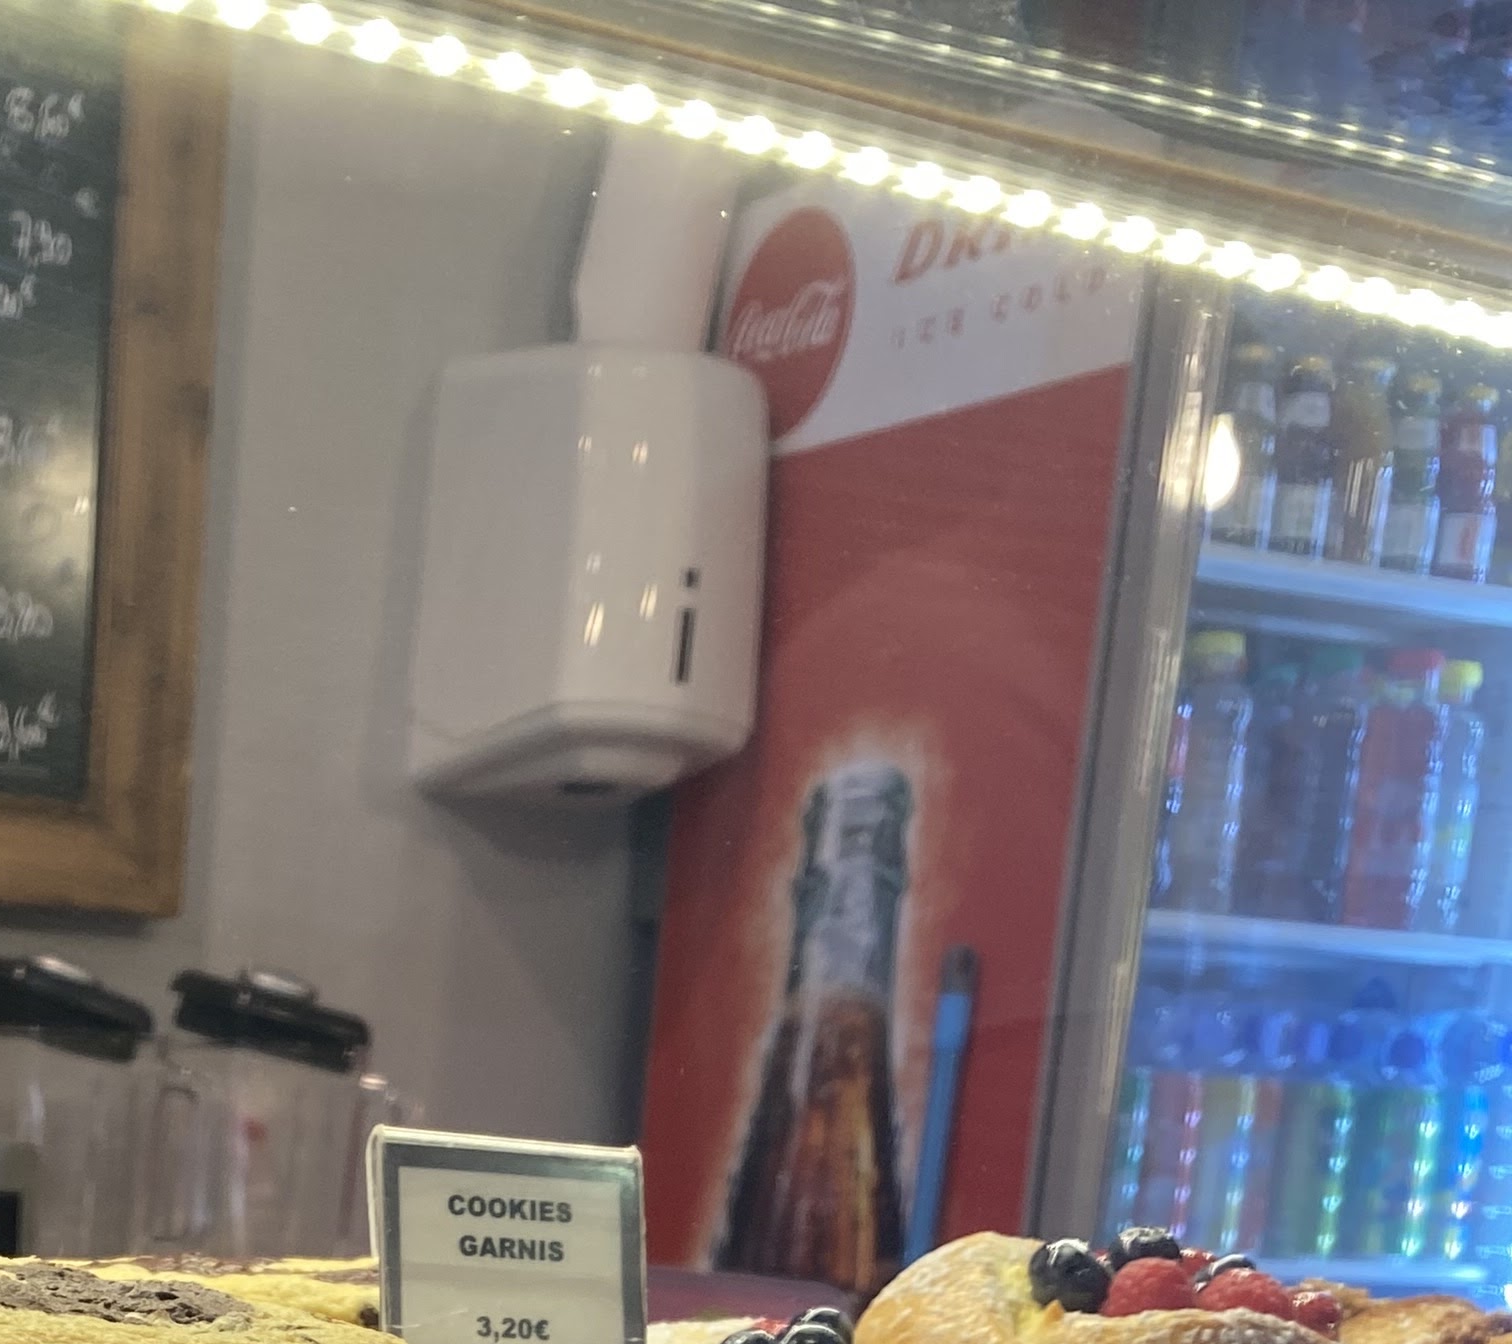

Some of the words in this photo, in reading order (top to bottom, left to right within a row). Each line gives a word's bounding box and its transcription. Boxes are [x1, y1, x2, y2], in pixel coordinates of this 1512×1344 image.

[447, 1193, 573, 1224] COOKIES
[458, 1234, 565, 1263] GARNIS
[476, 1315, 550, 1344] 3,20€
